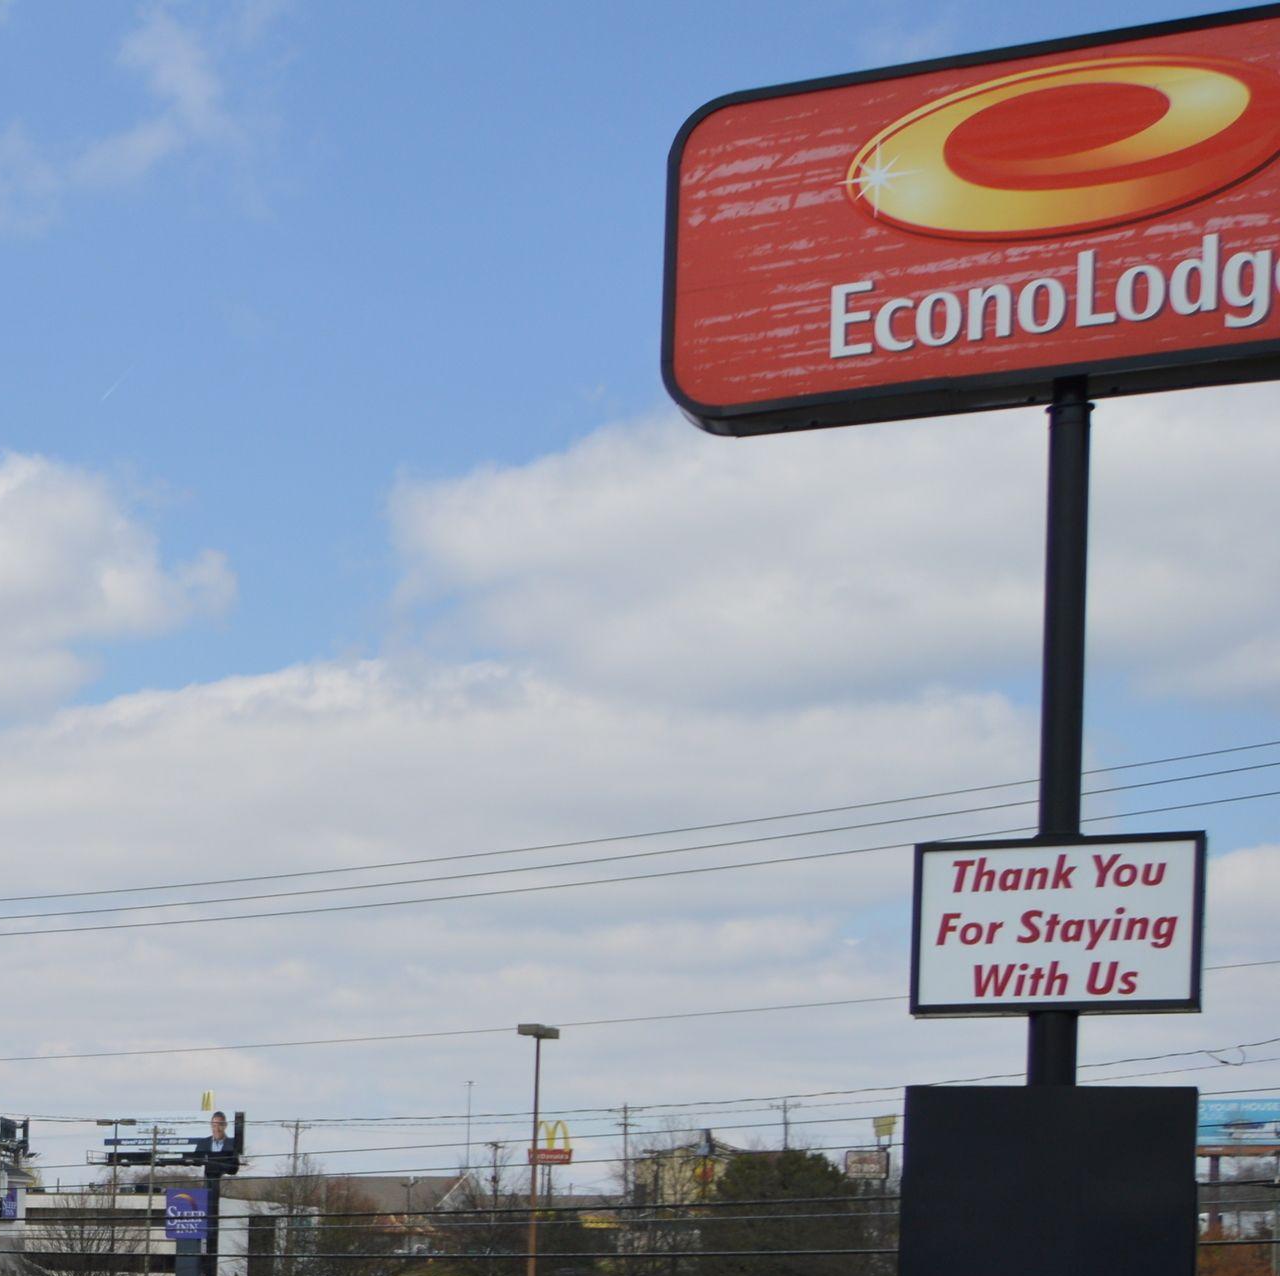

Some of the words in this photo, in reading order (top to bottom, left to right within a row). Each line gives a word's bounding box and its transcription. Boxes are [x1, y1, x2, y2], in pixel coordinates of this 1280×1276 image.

[829, 233, 1280, 360] EconoLodg
[952, 854, 1077, 893] Thank
[1092, 853, 1166, 888] You
[935, 912, 1004, 946] For
[1016, 906, 1178, 950] Staying
[972, 960, 1070, 997] With
[1085, 961, 1138, 996] Us
[167, 1205, 206, 1226] SLEEP
